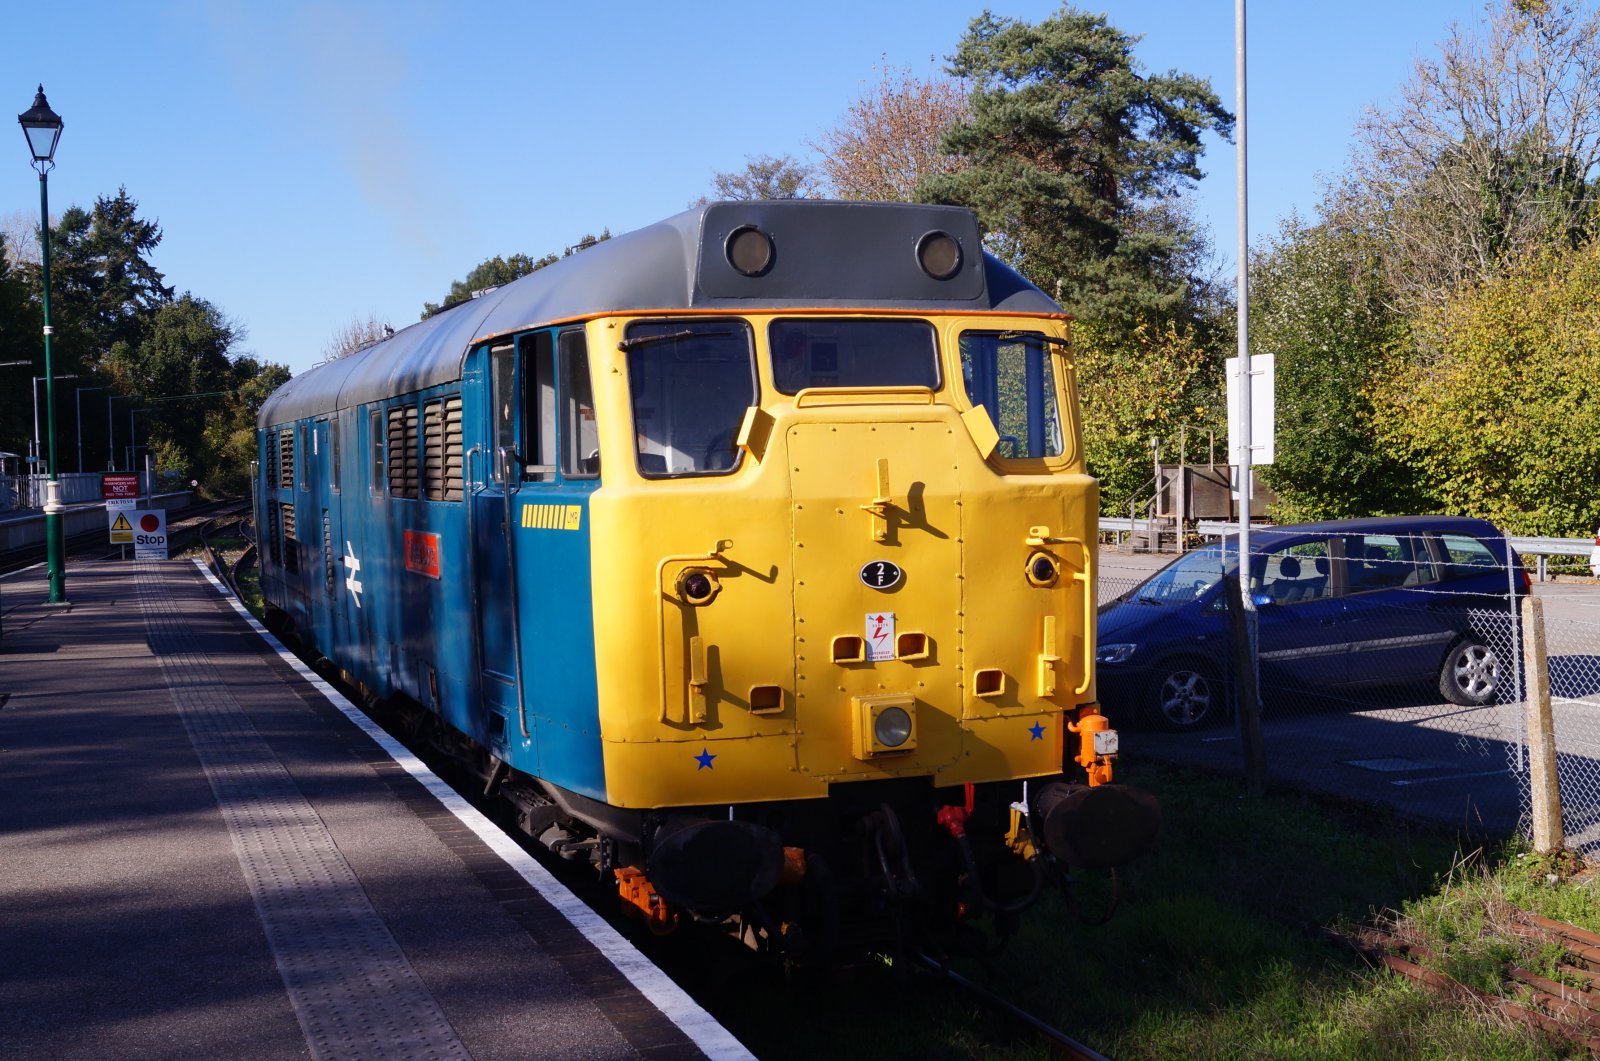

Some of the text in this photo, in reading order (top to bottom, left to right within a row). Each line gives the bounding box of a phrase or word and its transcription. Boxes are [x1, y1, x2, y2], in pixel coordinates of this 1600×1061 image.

[136, 534, 165, 546] Stop
[877, 563, 885, 575] 2
[877, 575, 884, 585] F
